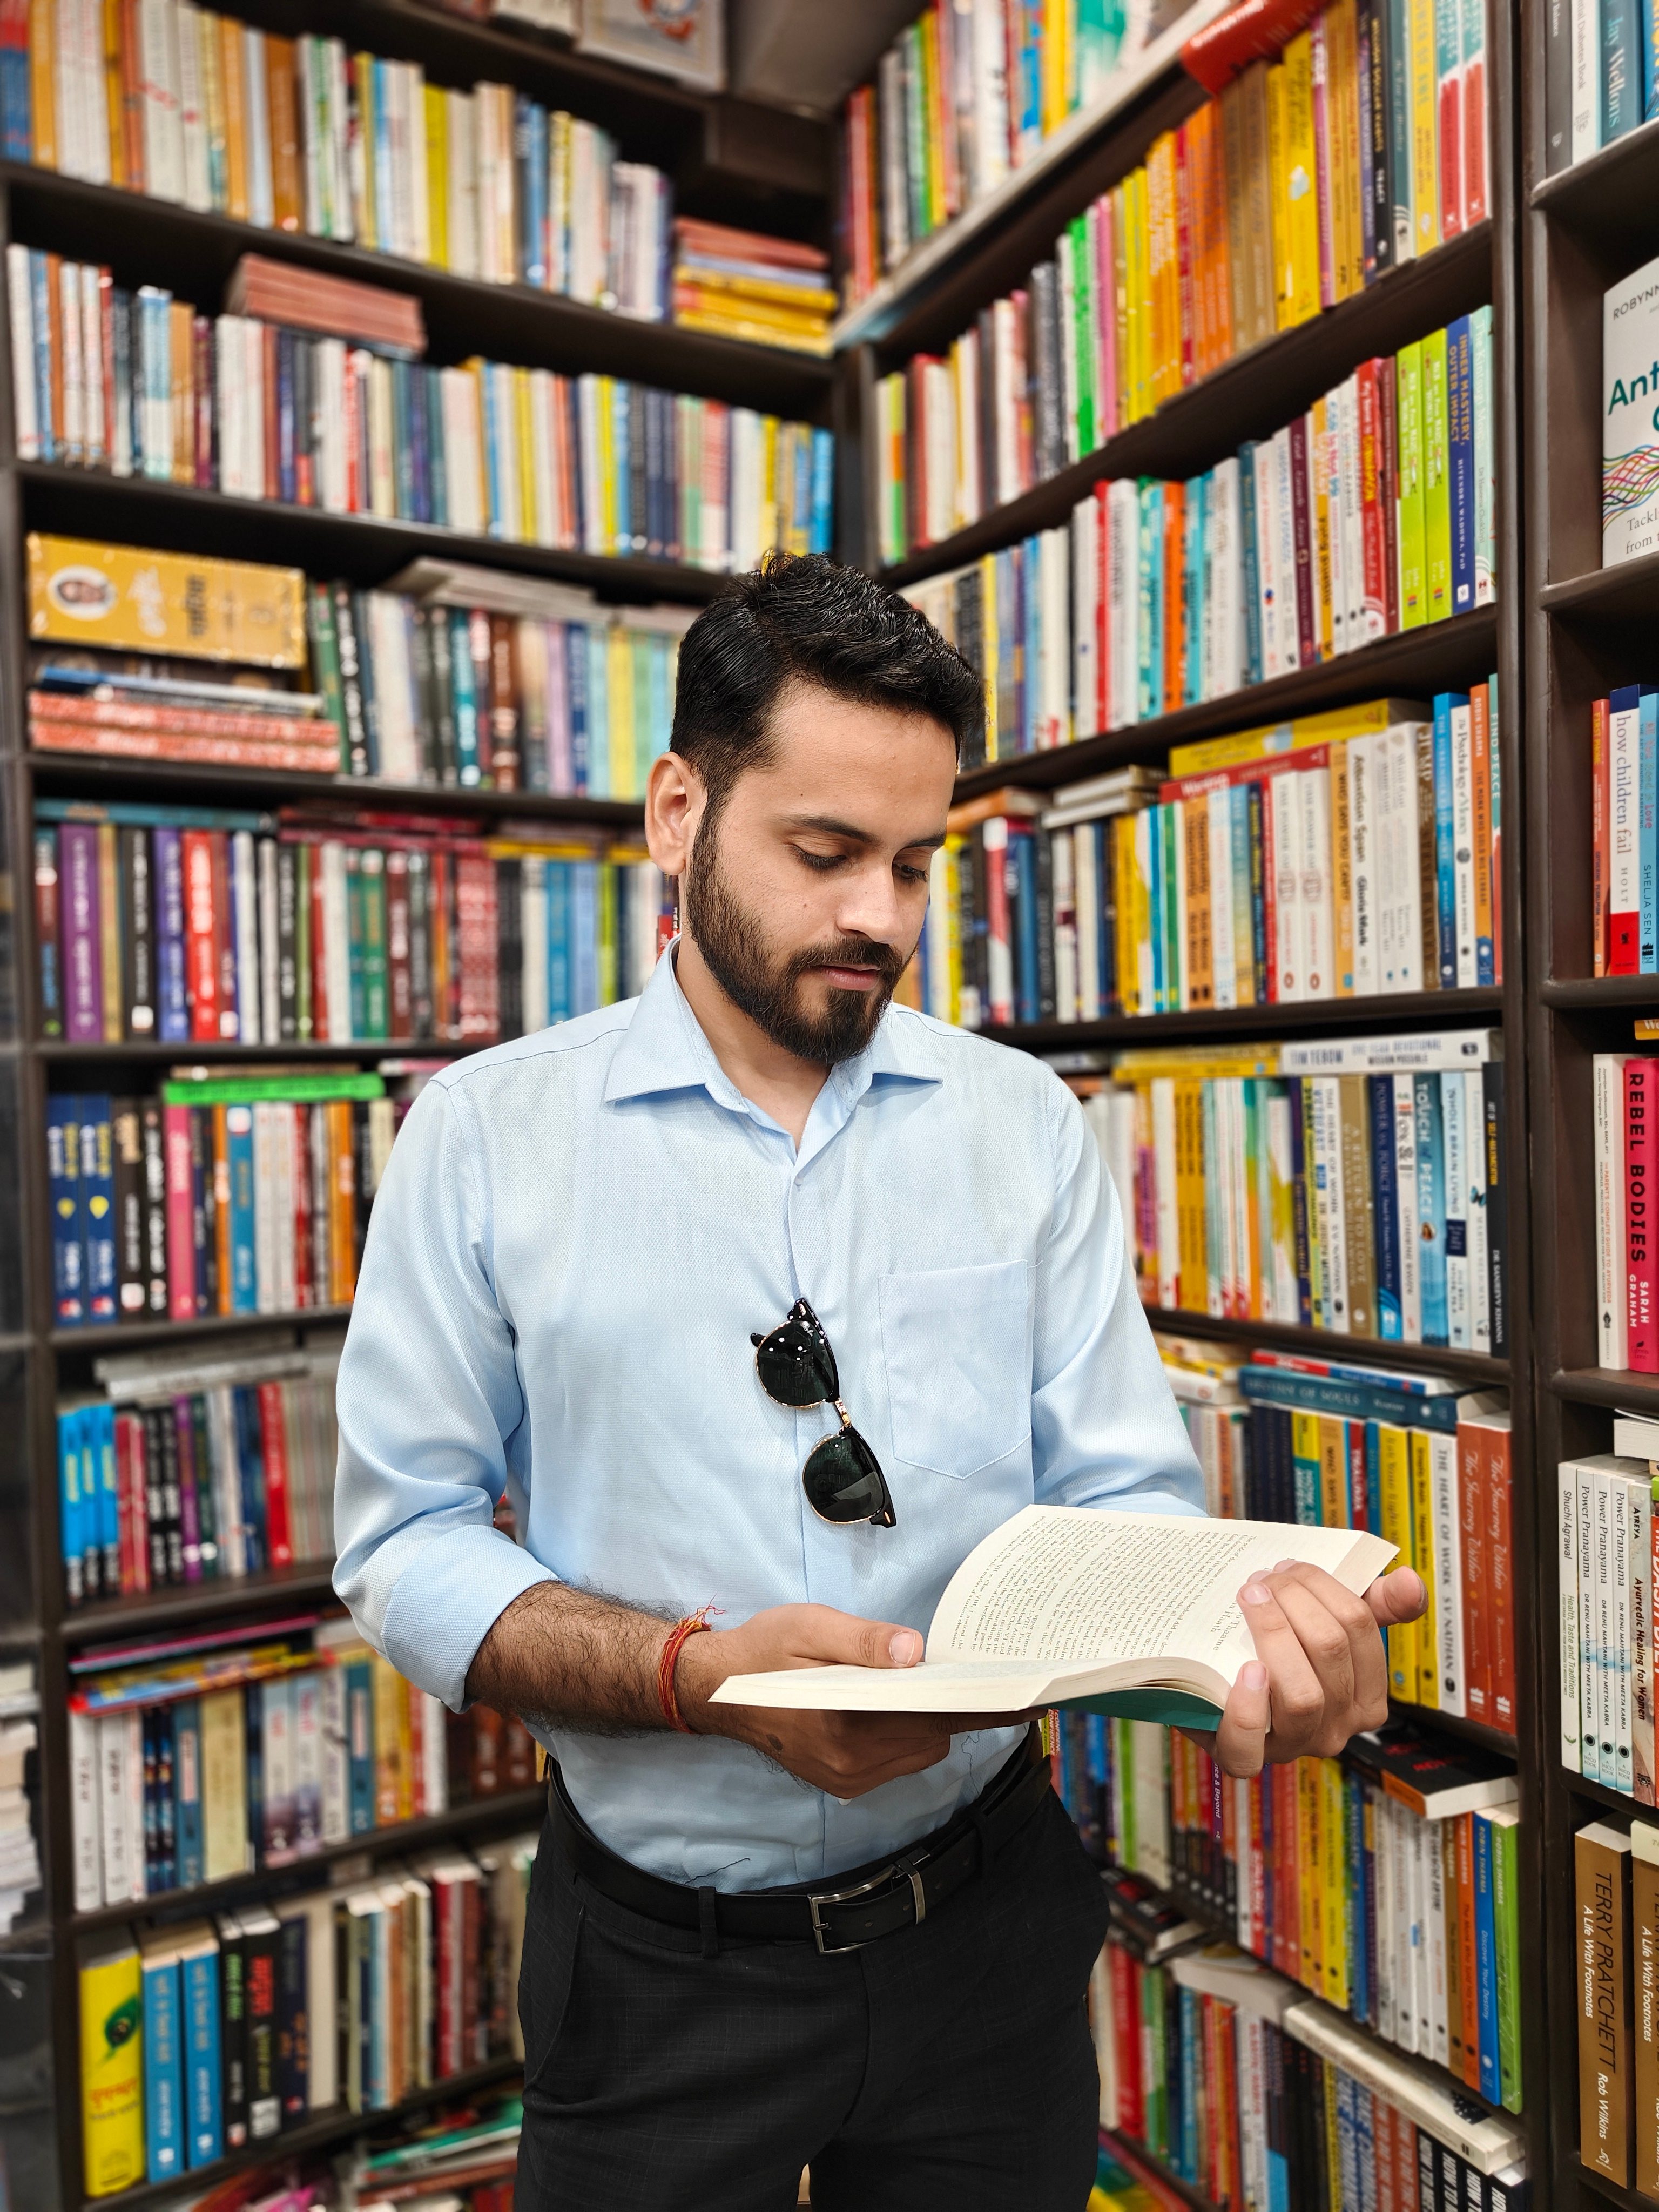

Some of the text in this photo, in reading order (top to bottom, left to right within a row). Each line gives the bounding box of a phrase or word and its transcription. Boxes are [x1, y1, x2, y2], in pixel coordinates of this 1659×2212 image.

[1577, 21, 1586, 90] Diabetes Book
[1604, 16, 1625, 128] Jay Wellons
[1460, 334, 1470, 446] INNER MASTERY,
[1451, 394, 1459, 442] IMPACT
[1626, 536, 1652, 554] from
[1474, 697, 1482, 723] ROBIN
[1593, 712, 1601, 737] FIRST
[1475, 725, 1483, 758] SHARMA
[1617, 715, 1631, 752] how
[1455, 732, 1468, 790] Psychology
[1491, 713, 1500, 800] FIND PEACE
[1593, 738, 1601, 765] PHONE
[1640, 752, 1644, 761] OF
[1617, 757, 1631, 825] children
[1645, 763, 1655, 788] Need
[1645, 792, 1655, 801] is
[1645, 804, 1655, 829] Love
[1617, 828, 1633, 854] fail
[1629, 1073, 1646, 1262] REBEL BODIES
[1488, 1122, 1498, 1186] SELF-MAXIMIZATION
[1495, 1307, 1503, 1344] KHANNA
[1606, 1258, 1611, 1267] TO
[1629, 1274, 1637, 1327] GRAHAM
[1640, 1280, 1649, 1324] SARAH
[1438, 1448, 1448, 1471] THE
[1439, 1477, 1449, 1516] HEART
[1441, 1523, 1450, 1542] OF
[1462, 1449, 1482, 1583] The Journey Within
[1488, 1454, 1508, 1590] The Journey Within
[1562, 1489, 1573, 1560] Shuchi Agrawal
[1580, 1486, 1591, 1579] Power Pranayama
[1237, 1542, 1247, 1551] pride
[1598, 1490, 1608, 1584] Power Pranayama
[1615, 1491, 1626, 1587] Power Pranayama
[1213, 1563, 1228, 1578] crimson
[1442, 1549, 1452, 1586] WORK
[972, 1595, 981, 1607] VIII,
[980, 1580, 989, 1592] Class
[1584, 1593, 1589, 1602] DR
[1177, 1602, 1195, 1620] forehead
[1211, 1611, 1233, 1632] Haath
[1602, 1599, 1607, 1609] DR
[1619, 1602, 1624, 1611] DR
[961, 1615, 970, 1636] noticed
[1171, 1621, 1179, 1629] did
[1213, 1621, 1240, 1650] Thaame
[1158, 1642, 1168, 1656] deter
[1445, 1618, 1455, 1669] NATHAN
[1566, 1595, 1577, 1699] Health, Taste and Traditions
[1634, 1577, 1647, 1721] Ayurvedic Healing for Women
[1583, 1905, 1595, 2019] A Life With Footnotes
[1596, 1872, 1616, 2074] TERRY PRATCHETT
[1642, 1926, 1654, 2043] A Life With Footnotes
[1481, 1988, 1490, 2022] Destiny
[1597, 2072, 1609, 2140] Rob Wilkins
